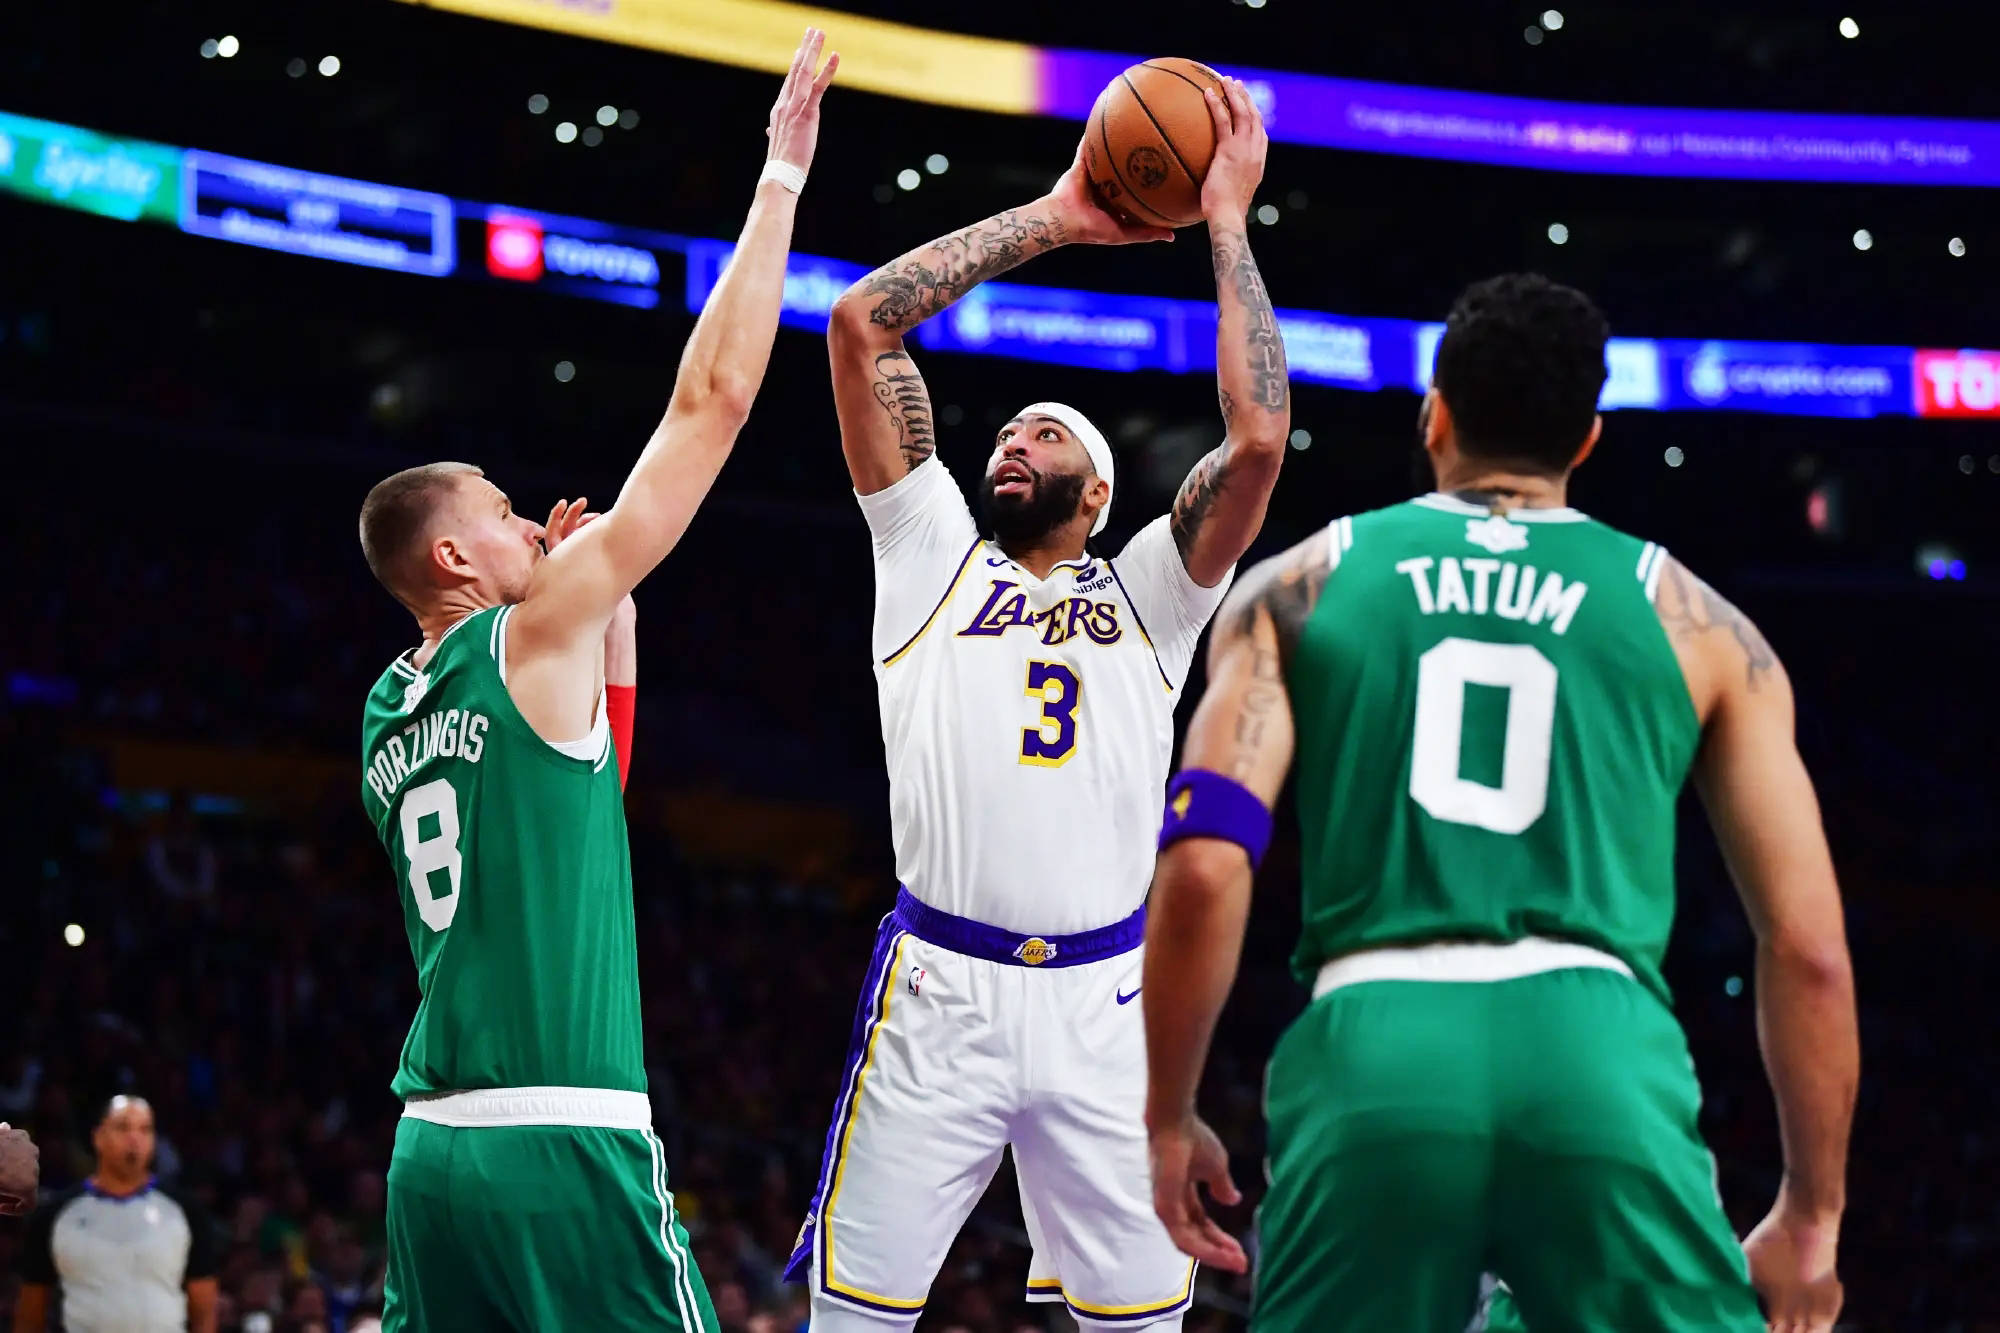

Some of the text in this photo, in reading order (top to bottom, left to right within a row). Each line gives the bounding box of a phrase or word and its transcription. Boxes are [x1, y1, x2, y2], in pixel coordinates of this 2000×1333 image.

[545, 234, 659, 285] TOYOTA
[991, 308, 1155, 347] crypto.com
[1727, 363, 1891, 398] crypto.com
[1924, 358, 2000, 411] TO
[955, 580, 1122, 647] LAERS
[1396, 556, 1588, 635] TATUM
[1018, 658, 1081, 768] 3
[1409, 637, 1558, 835] 0
[367, 709, 489, 808] PORZINGIS
[400, 778, 462, 932] 8
